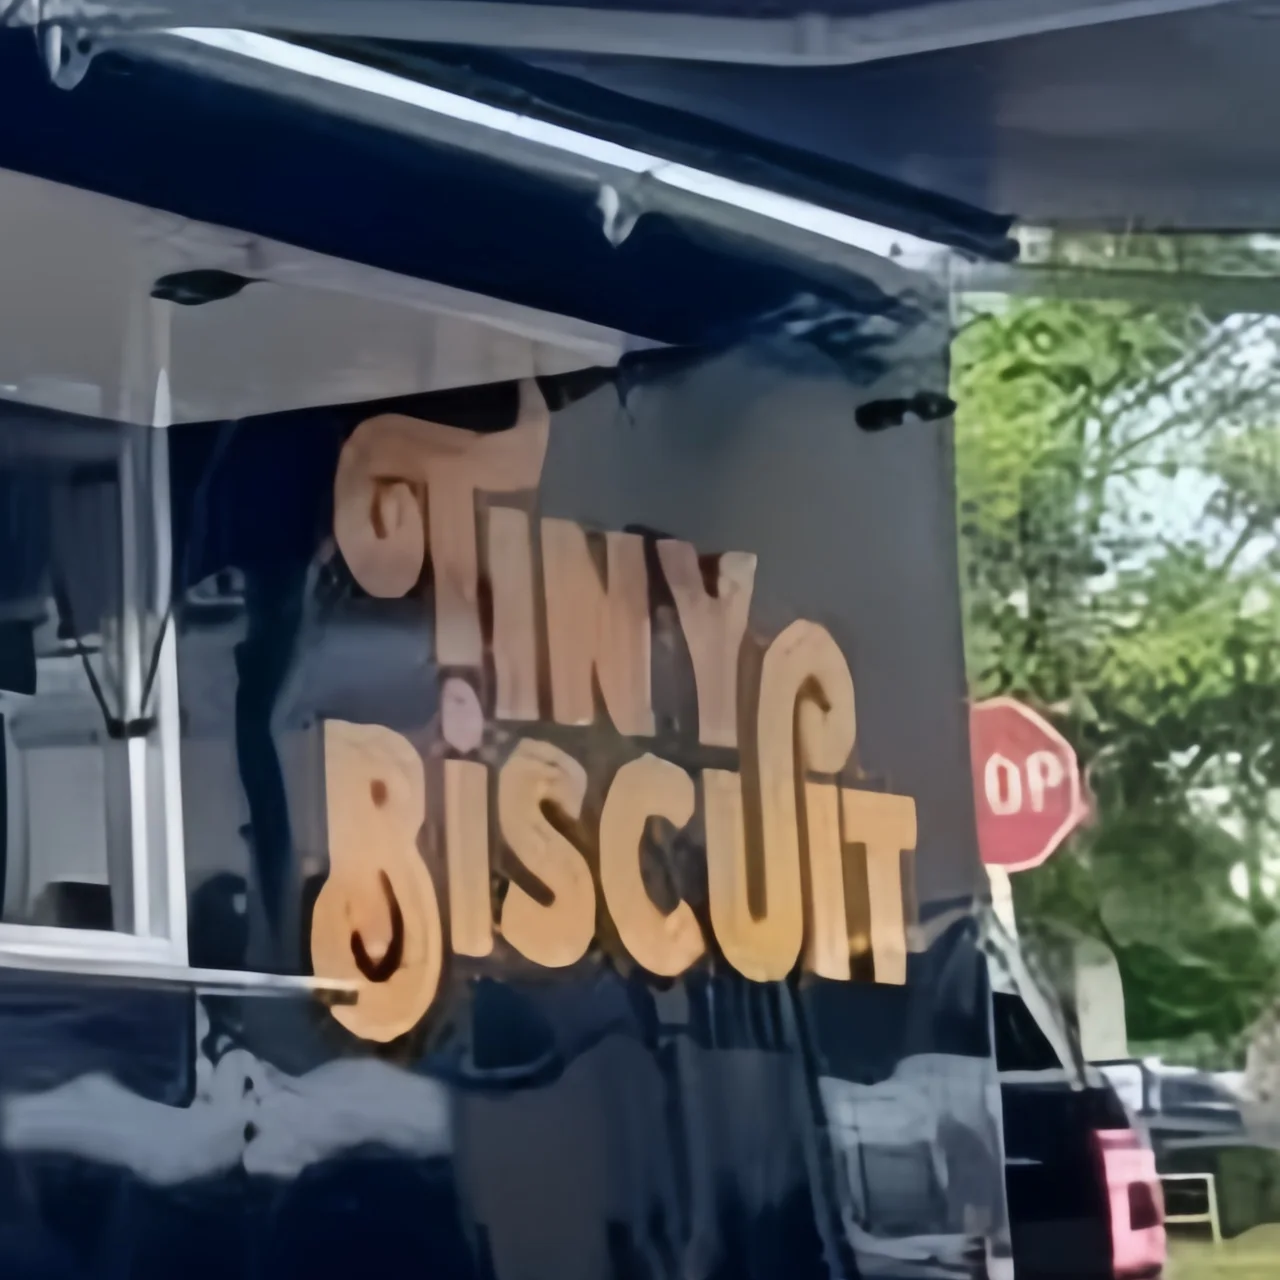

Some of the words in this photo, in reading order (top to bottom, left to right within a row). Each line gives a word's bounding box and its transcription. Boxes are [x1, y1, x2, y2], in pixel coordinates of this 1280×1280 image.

[333, 377, 758, 748] TINY
[310, 618, 918, 1043] BISCUIT
[983, 750, 1064, 816] OP
